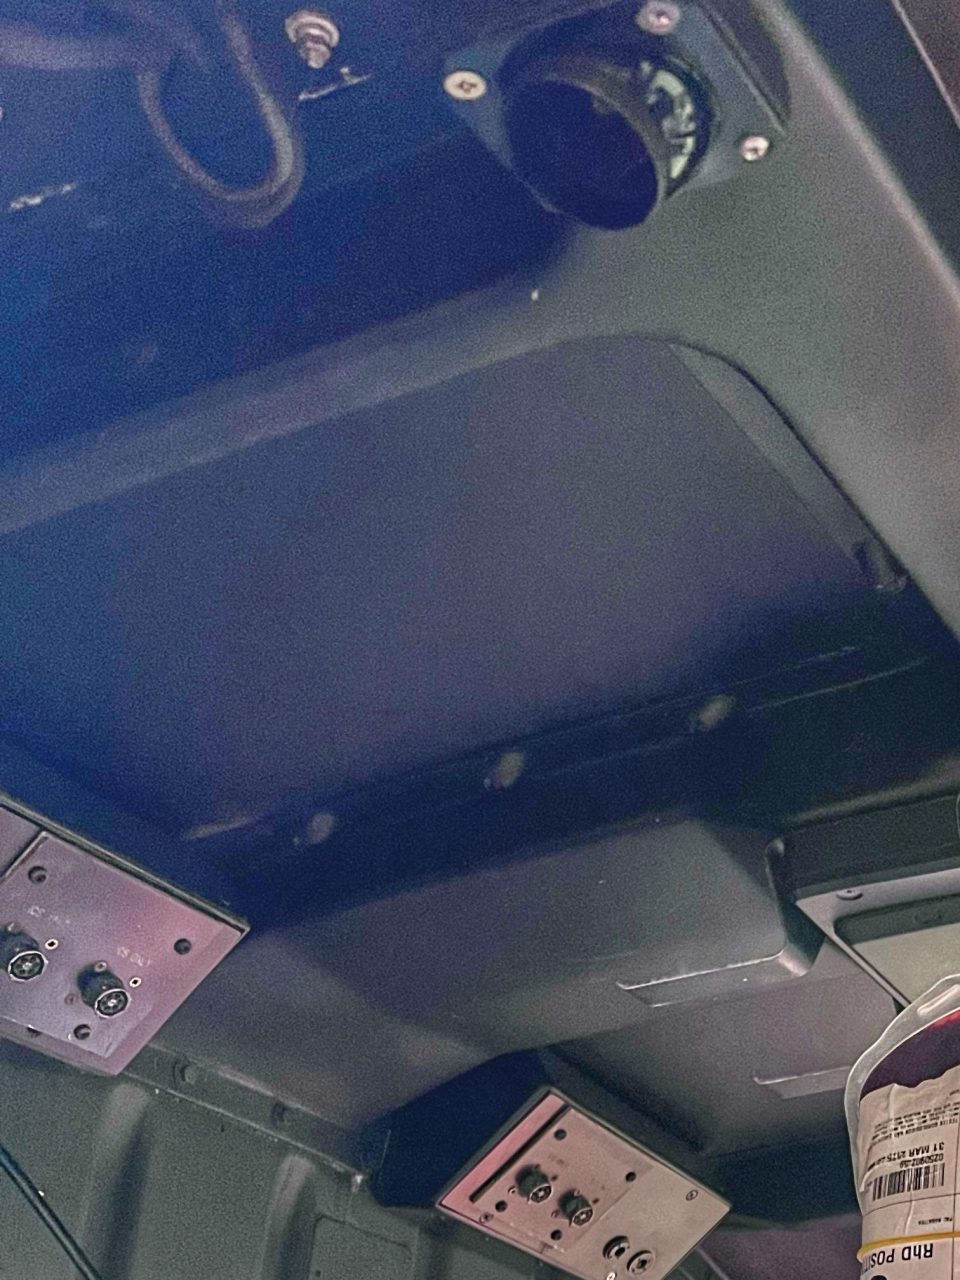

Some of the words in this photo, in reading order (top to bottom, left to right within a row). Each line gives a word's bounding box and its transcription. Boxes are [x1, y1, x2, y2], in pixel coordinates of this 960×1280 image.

[909, 1145, 929, 1157] MAR
[933, 1142, 944, 1151] 31
[902, 1243, 933, 1261] RhD
